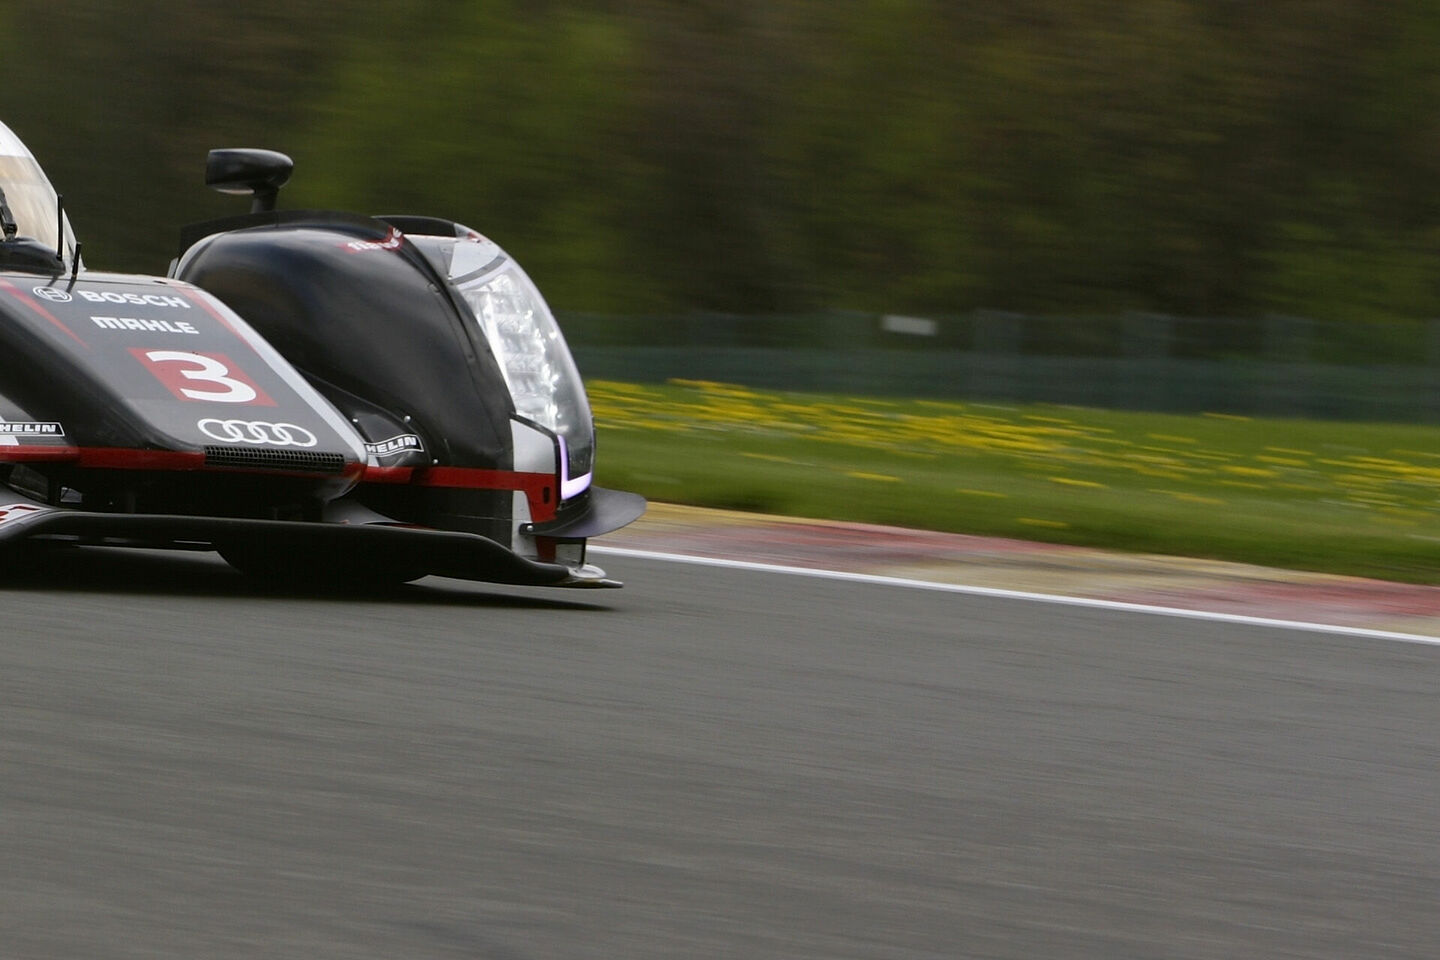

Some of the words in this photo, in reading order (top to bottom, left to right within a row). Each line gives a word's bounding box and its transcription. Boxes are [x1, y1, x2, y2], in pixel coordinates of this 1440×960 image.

[77, 290, 191, 309] BOSCH
[90, 316, 200, 335] MAHLE
[145, 350, 257, 403] 3
[365, 436, 417, 453] HELIN
